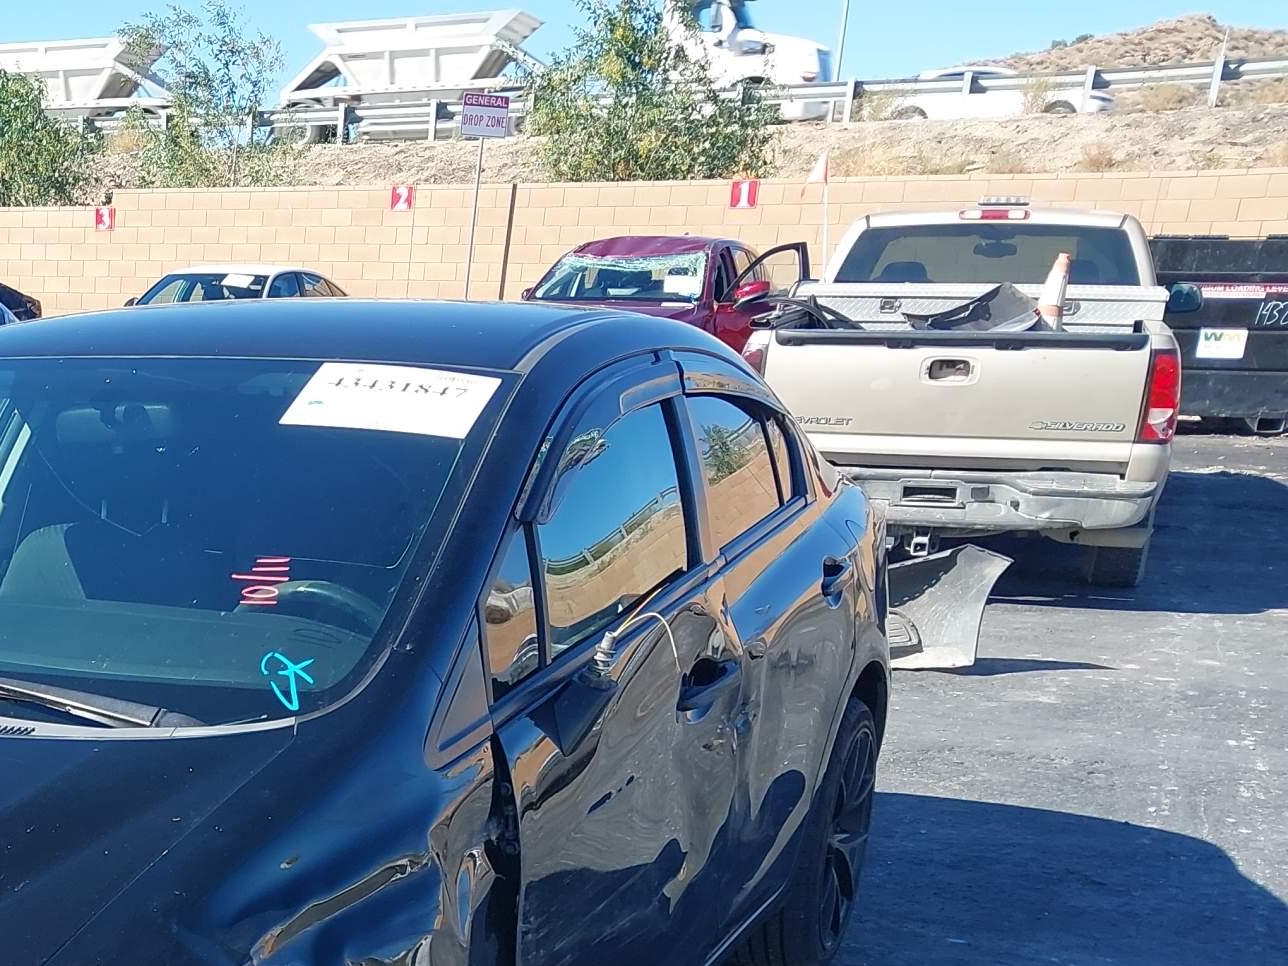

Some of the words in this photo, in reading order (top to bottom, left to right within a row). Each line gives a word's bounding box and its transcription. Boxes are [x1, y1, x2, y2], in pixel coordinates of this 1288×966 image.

[465, 95, 508, 108] GENERAL
[463, 113, 484, 127] DROP
[485, 115, 506, 129] ZONE
[327, 377, 469, 398] 43431847
[794, 416, 854, 426] EVROLET
[1044, 420, 1126, 432] SILVERADO
